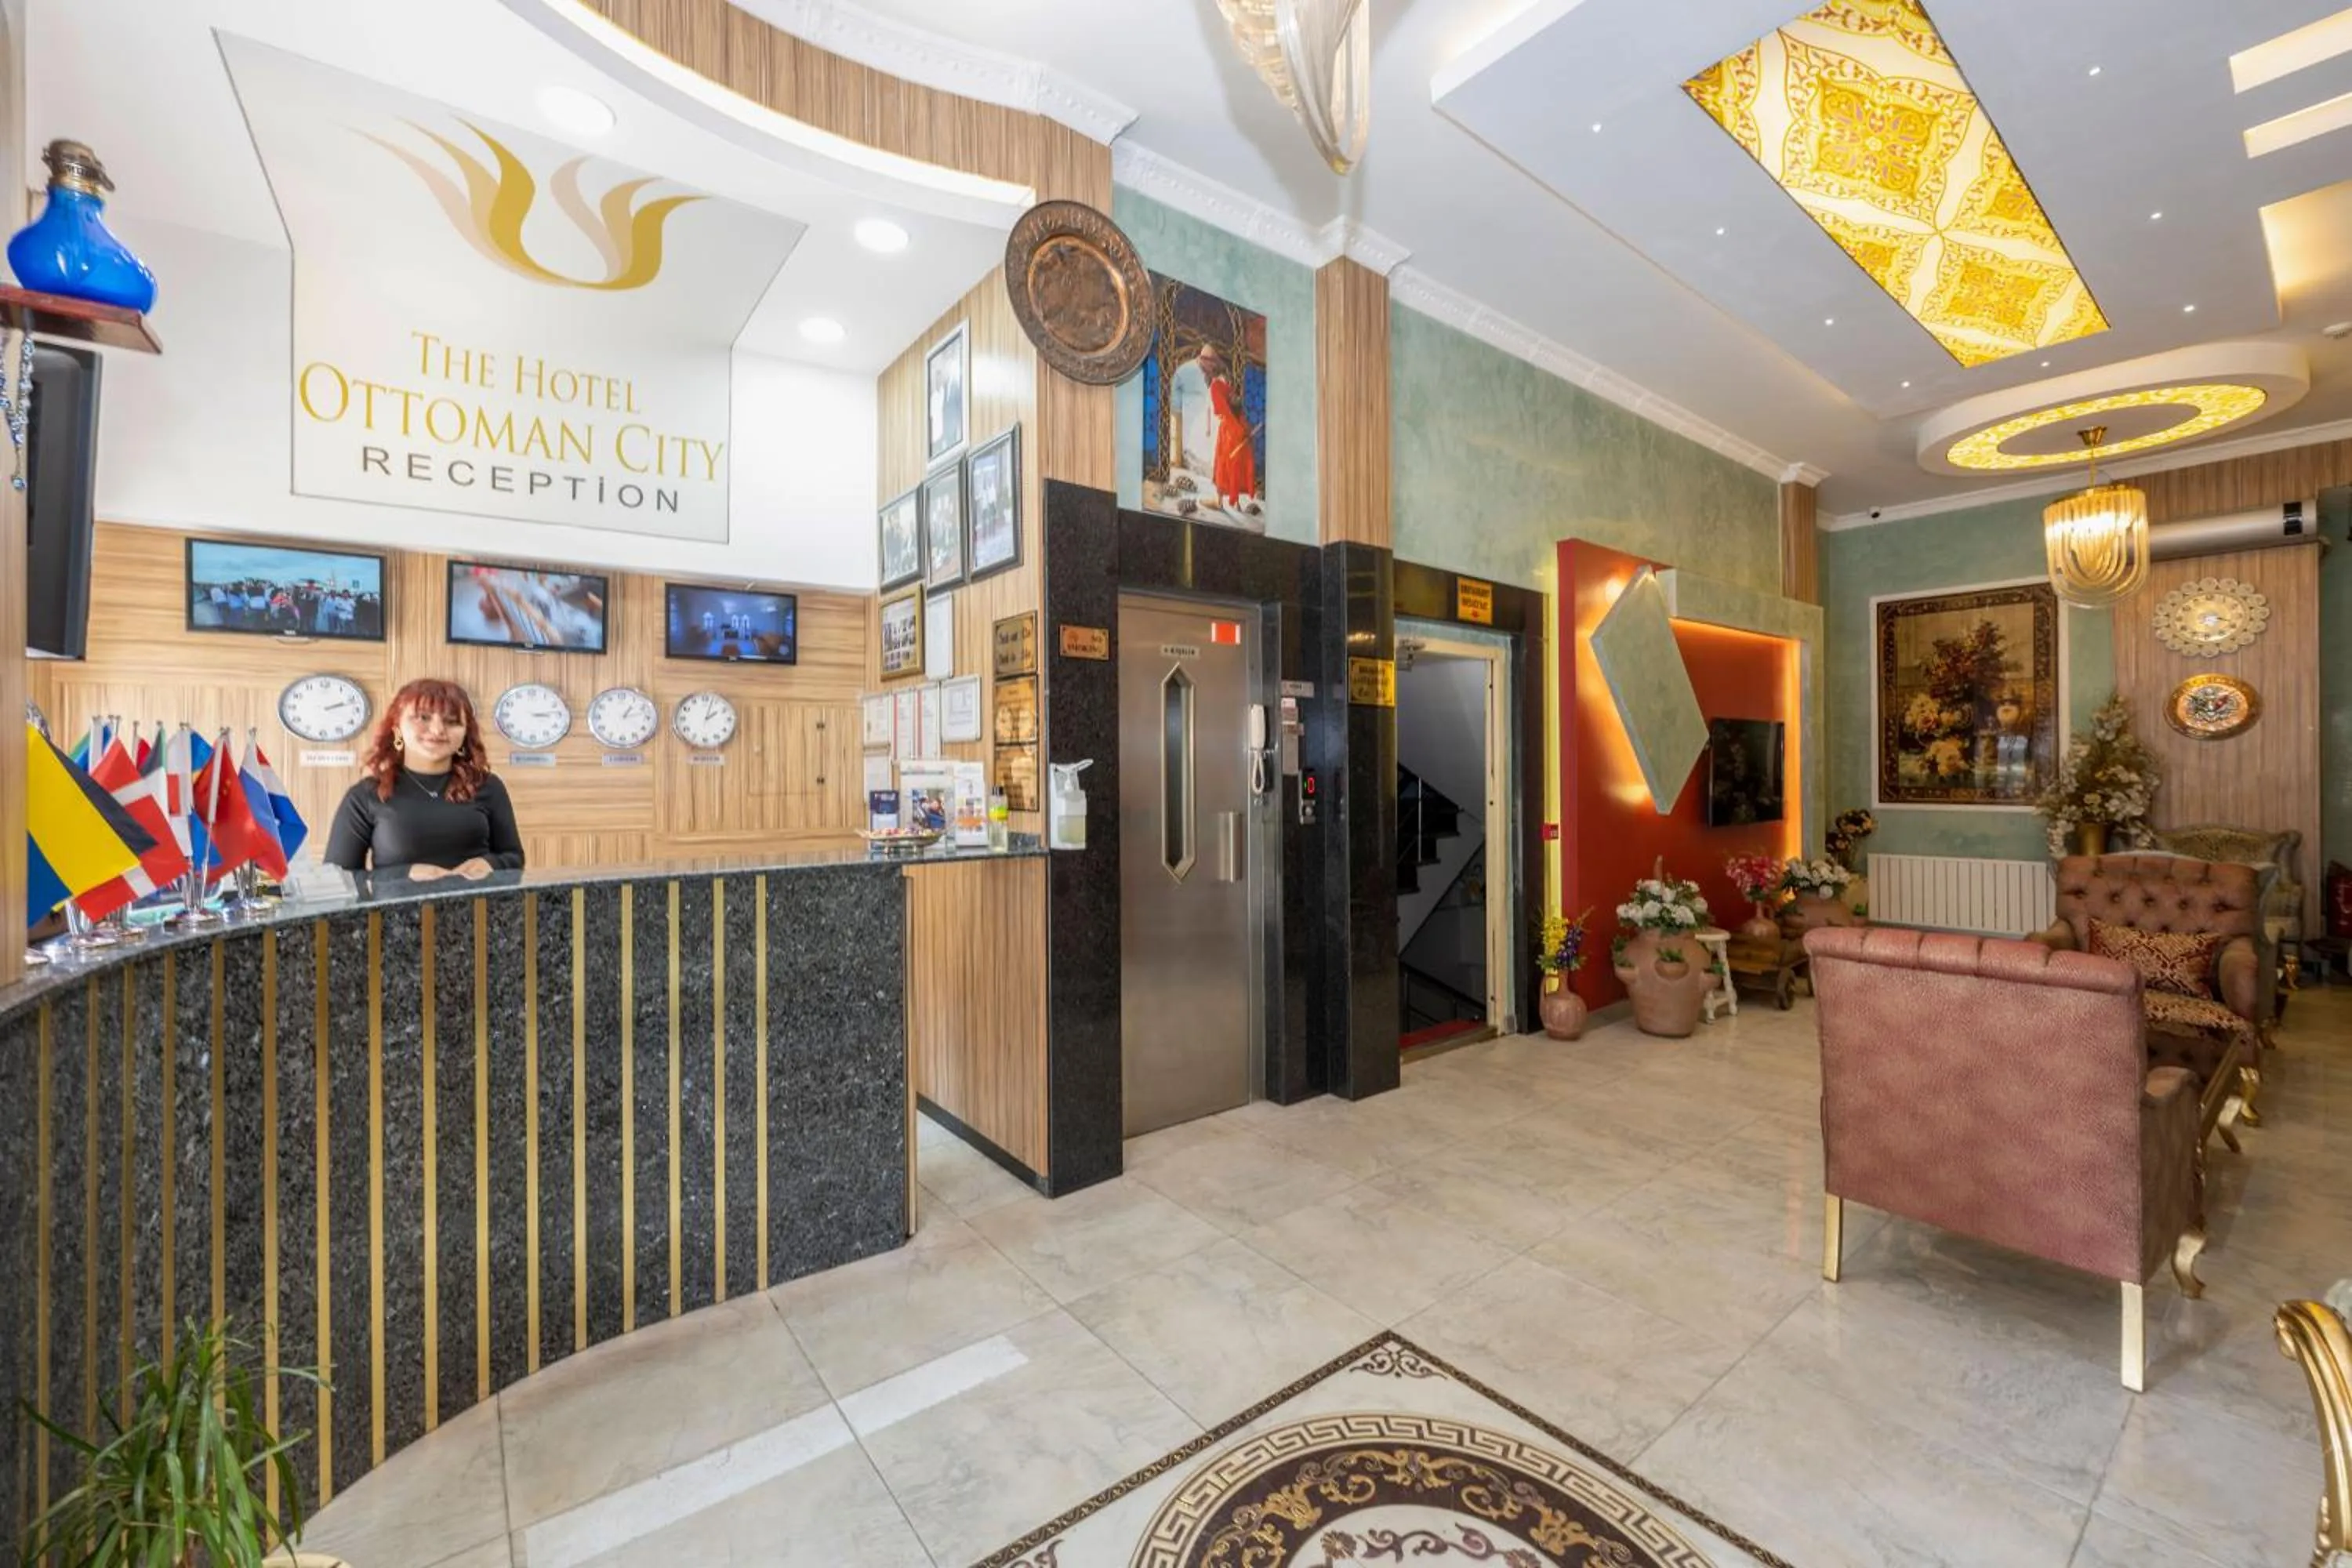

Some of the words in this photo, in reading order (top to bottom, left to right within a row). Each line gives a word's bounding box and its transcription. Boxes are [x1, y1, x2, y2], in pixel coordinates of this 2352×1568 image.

[299, 361, 593, 466] OTTOMAN
[615, 423, 724, 481] CITY
[412, 330, 495, 389] THE
[515, 355, 641, 414] HOTEL
